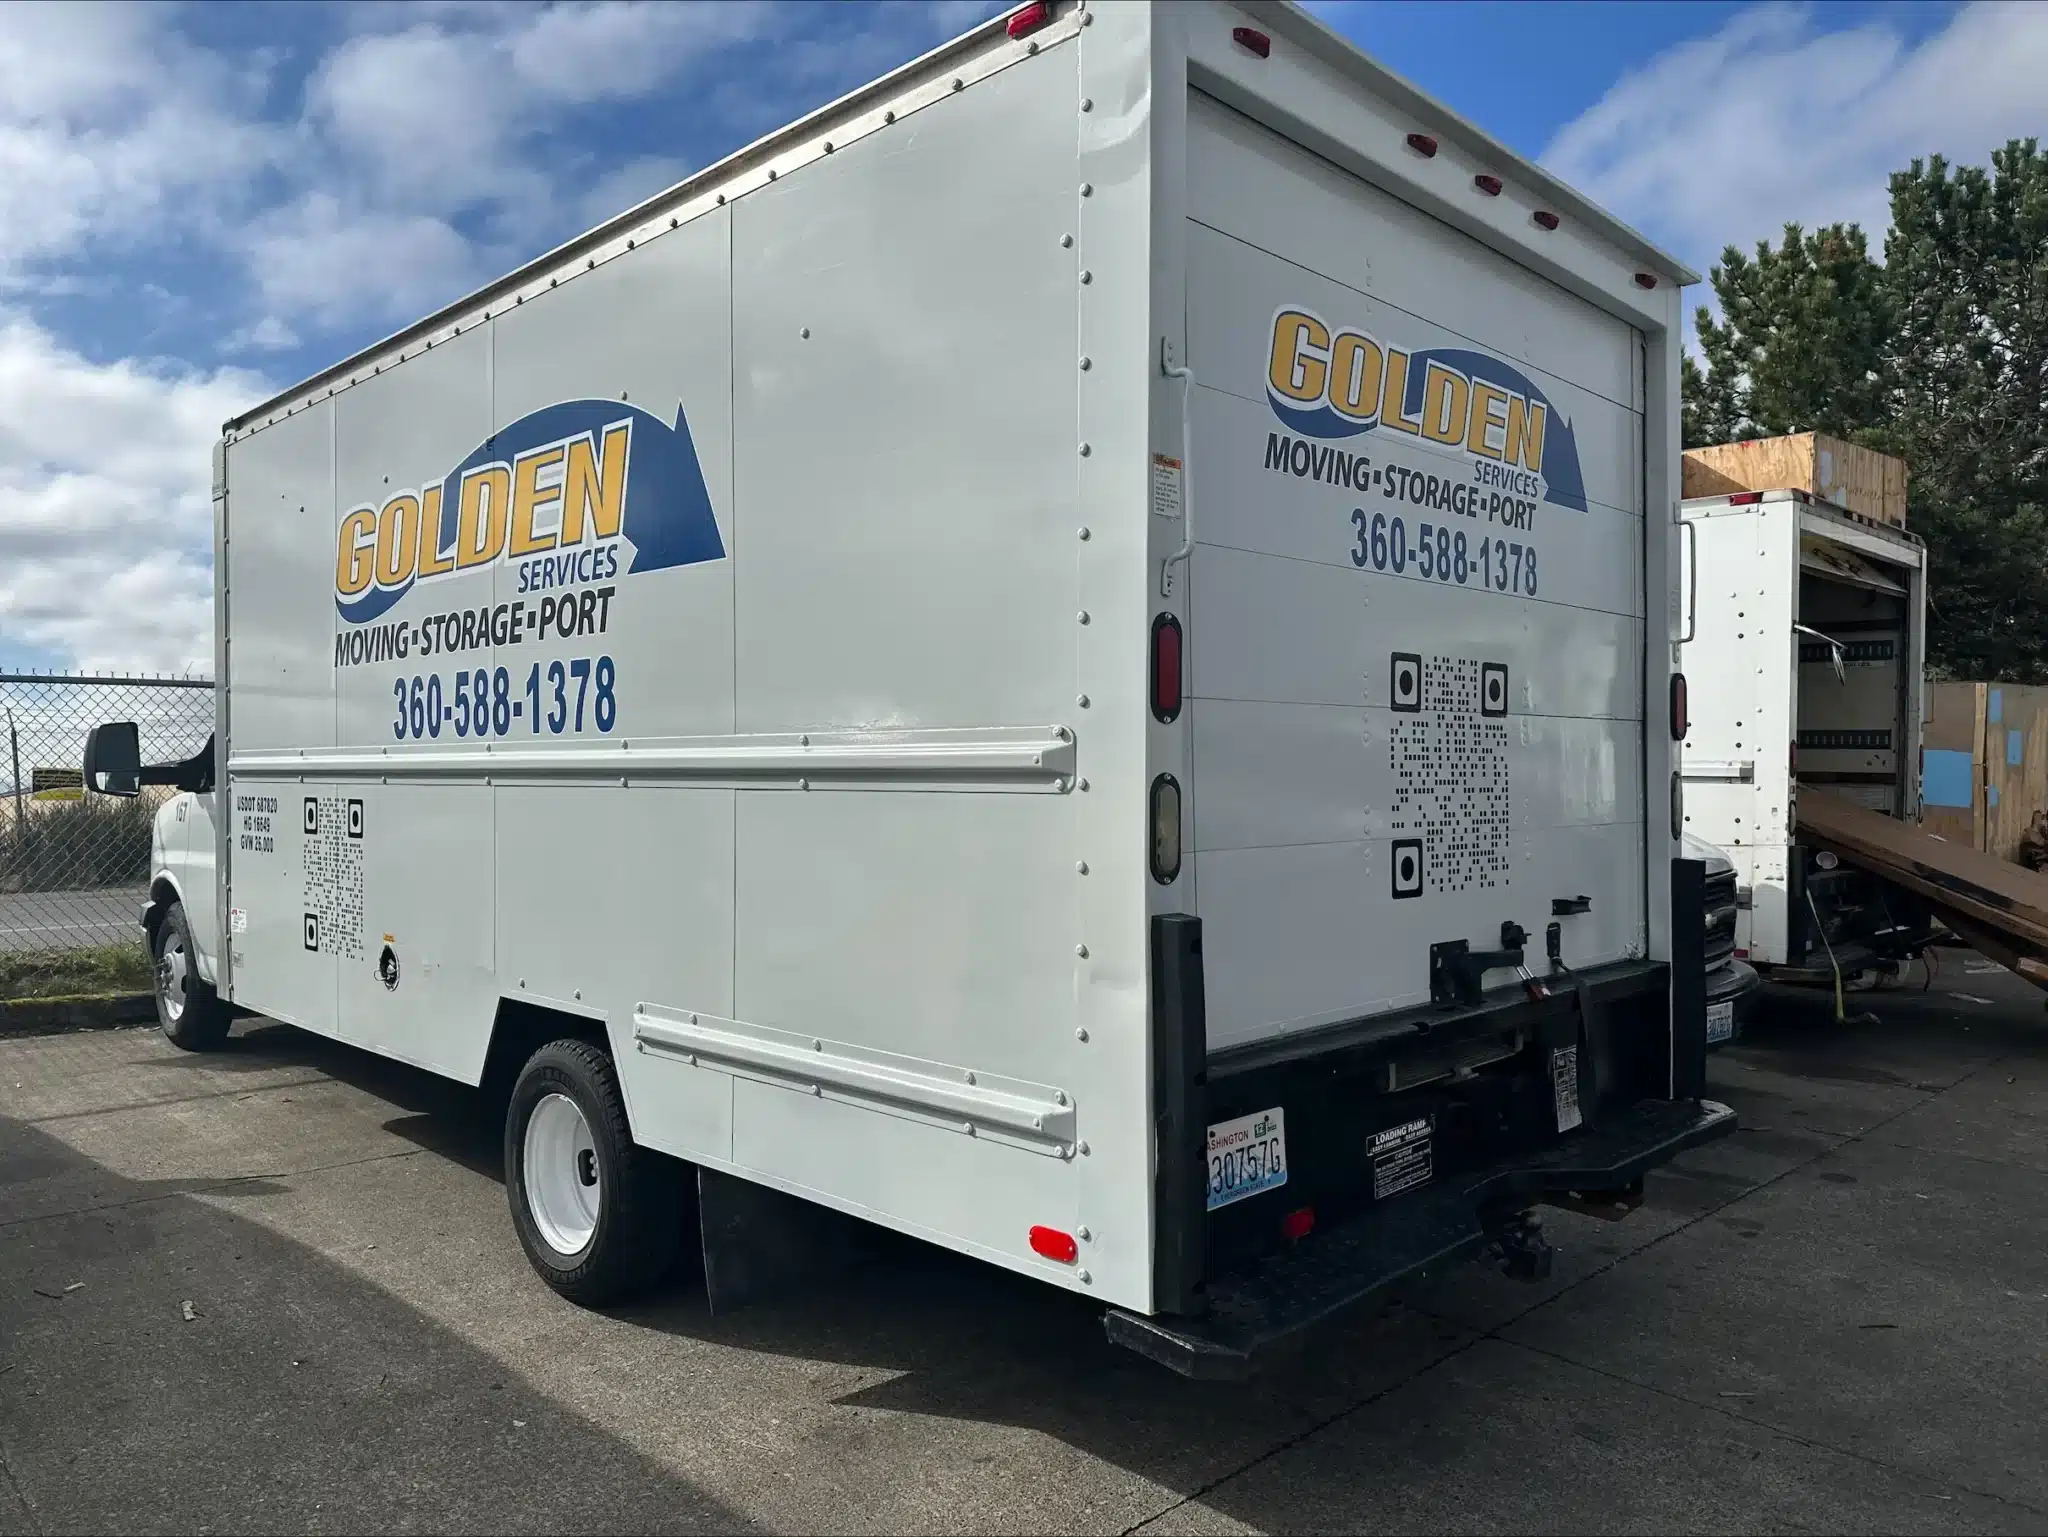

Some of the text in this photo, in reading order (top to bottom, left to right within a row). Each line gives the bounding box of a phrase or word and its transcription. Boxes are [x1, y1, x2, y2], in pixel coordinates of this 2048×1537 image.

[1267, 309, 1547, 472] GOLDEN
[1264, 433, 1536, 531] MOVING STORAGE PORT
[1474, 460, 1539, 498] SERVICES
[335, 424, 630, 596] GOLDEN
[518, 544, 618, 593] SERVICES
[1350, 508, 1537, 596] 360-588-1378
[334, 586, 615, 668] MOVING STORAGE PORT
[393, 655, 616, 740] 360-588-1378
[236, 796, 278, 813] USDOT 687820
[244, 816, 252, 831] HG
[240, 834, 273, 855] GVW 26,000
[1207, 1130, 1249, 1151] ASHINGTON
[1375, 1126, 1407, 1145] LOADING
